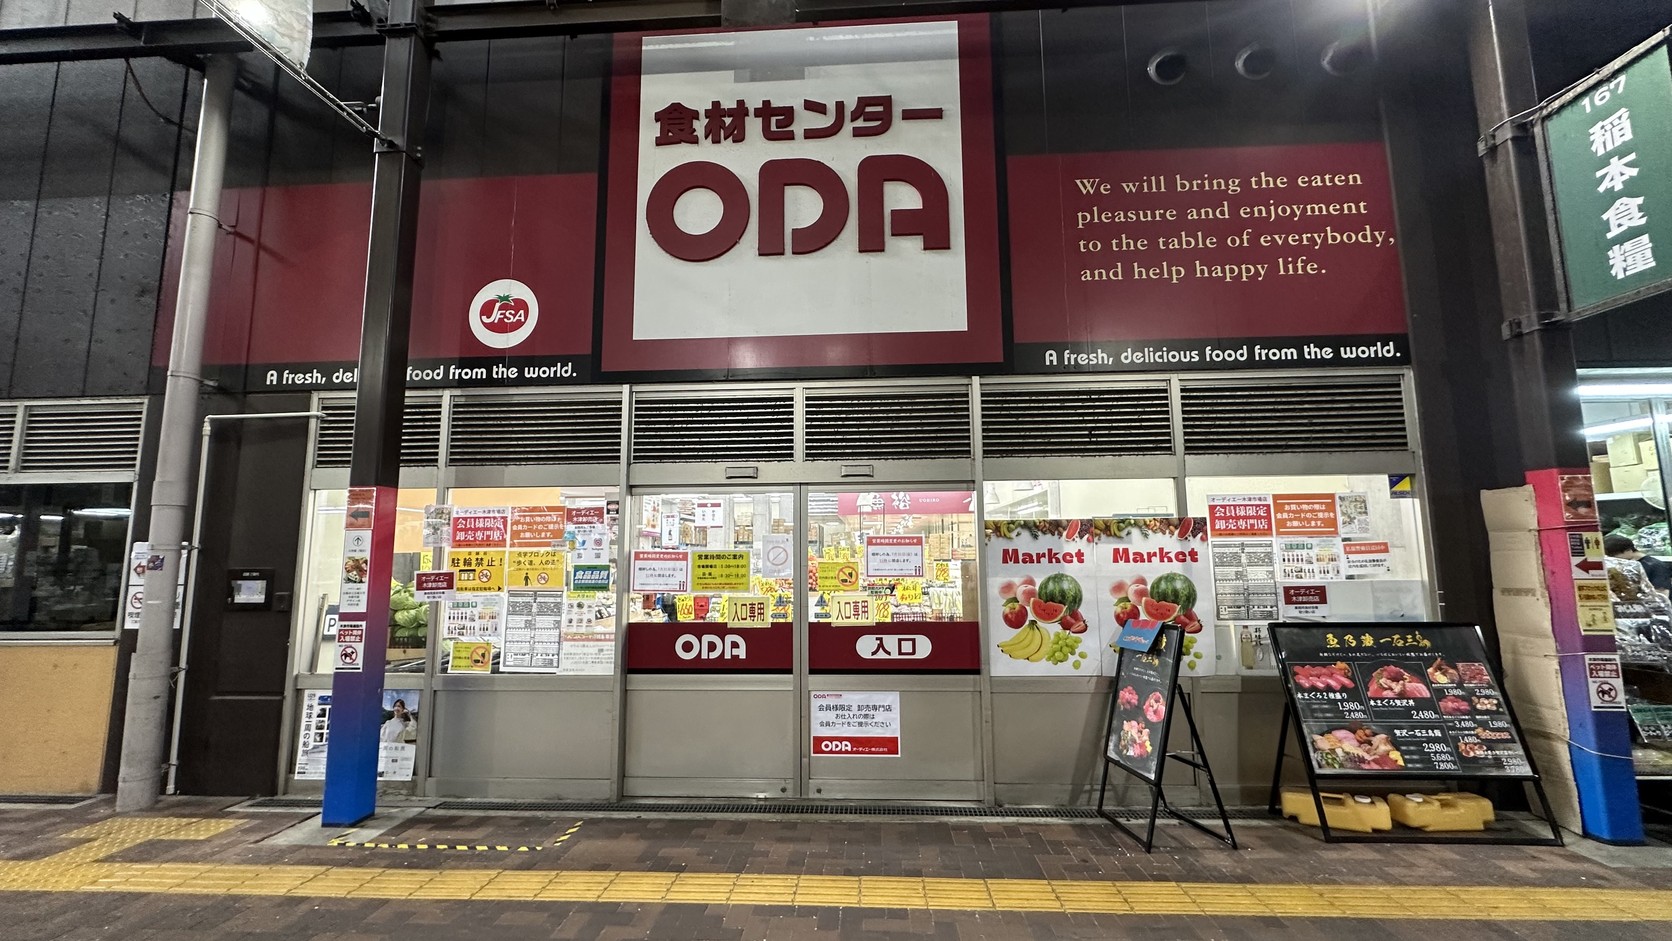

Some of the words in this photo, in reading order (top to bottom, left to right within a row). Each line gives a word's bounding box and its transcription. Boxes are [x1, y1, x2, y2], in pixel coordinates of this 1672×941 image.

[1581, 74, 1627, 114] 167
[655, 95, 944, 146] 食材センター
[1075, 178, 1111, 195] We
[1121, 176, 1166, 193] will
[1175, 174, 1241, 194] bring
[1250, 172, 1288, 189] the
[1297, 173, 1363, 187] eaten
[1588, 107, 1657, 280] 稲本食糧
[646, 154, 951, 262] ODA
[1077, 206, 1177, 229] pleasure
[1187, 201, 1230, 219] and
[1240, 200, 1368, 222] enjoyment
[1079, 239, 1101, 252] to
[1111, 234, 1148, 251] the
[1158, 231, 1217, 250] table
[1227, 229, 1252, 248] of
[1260, 225, 1395, 249] everybody,
[1081, 263, 1123, 281] and
[1133, 262, 1185, 284] help
[1195, 260, 1268, 282] happy
[1278, 256, 1327, 275] life.
[481, 302, 525, 323] JFSA
[1045, 350, 1058, 365] A
[1064, 349, 1113, 365] fresh,
[1120, 347, 1200, 364] delicious
[1205, 345, 1248, 362] food
[1254, 345, 1298, 361] from
[1303, 343, 1334, 360] the
[1340, 341, 1401, 359] world.
[266, 370, 278, 385] A
[282, 369, 327, 385] fresh,
[406, 365, 444, 381] food
[449, 364, 487, 380] from
[492, 363, 518, 379] the
[524, 362, 577, 378] world.
[1214, 505, 1268, 517] 会員様限定
[1215, 519, 1268, 530] 卸売専門店
[455, 530, 503, 541] 卸売専門店
[1001, 548, 1085, 565] Market
[1112, 547, 1199, 563] Market
[732, 602, 764, 622] 入口専用
[836, 600, 868, 620] 入口専用
[675, 633, 746, 660] ODA
[870, 636, 916, 656] 入口
[818, 704, 853, 712] 会員様限定
[857, 704, 892, 712] 卸売専門店
[821, 740, 852, 752] ODA
